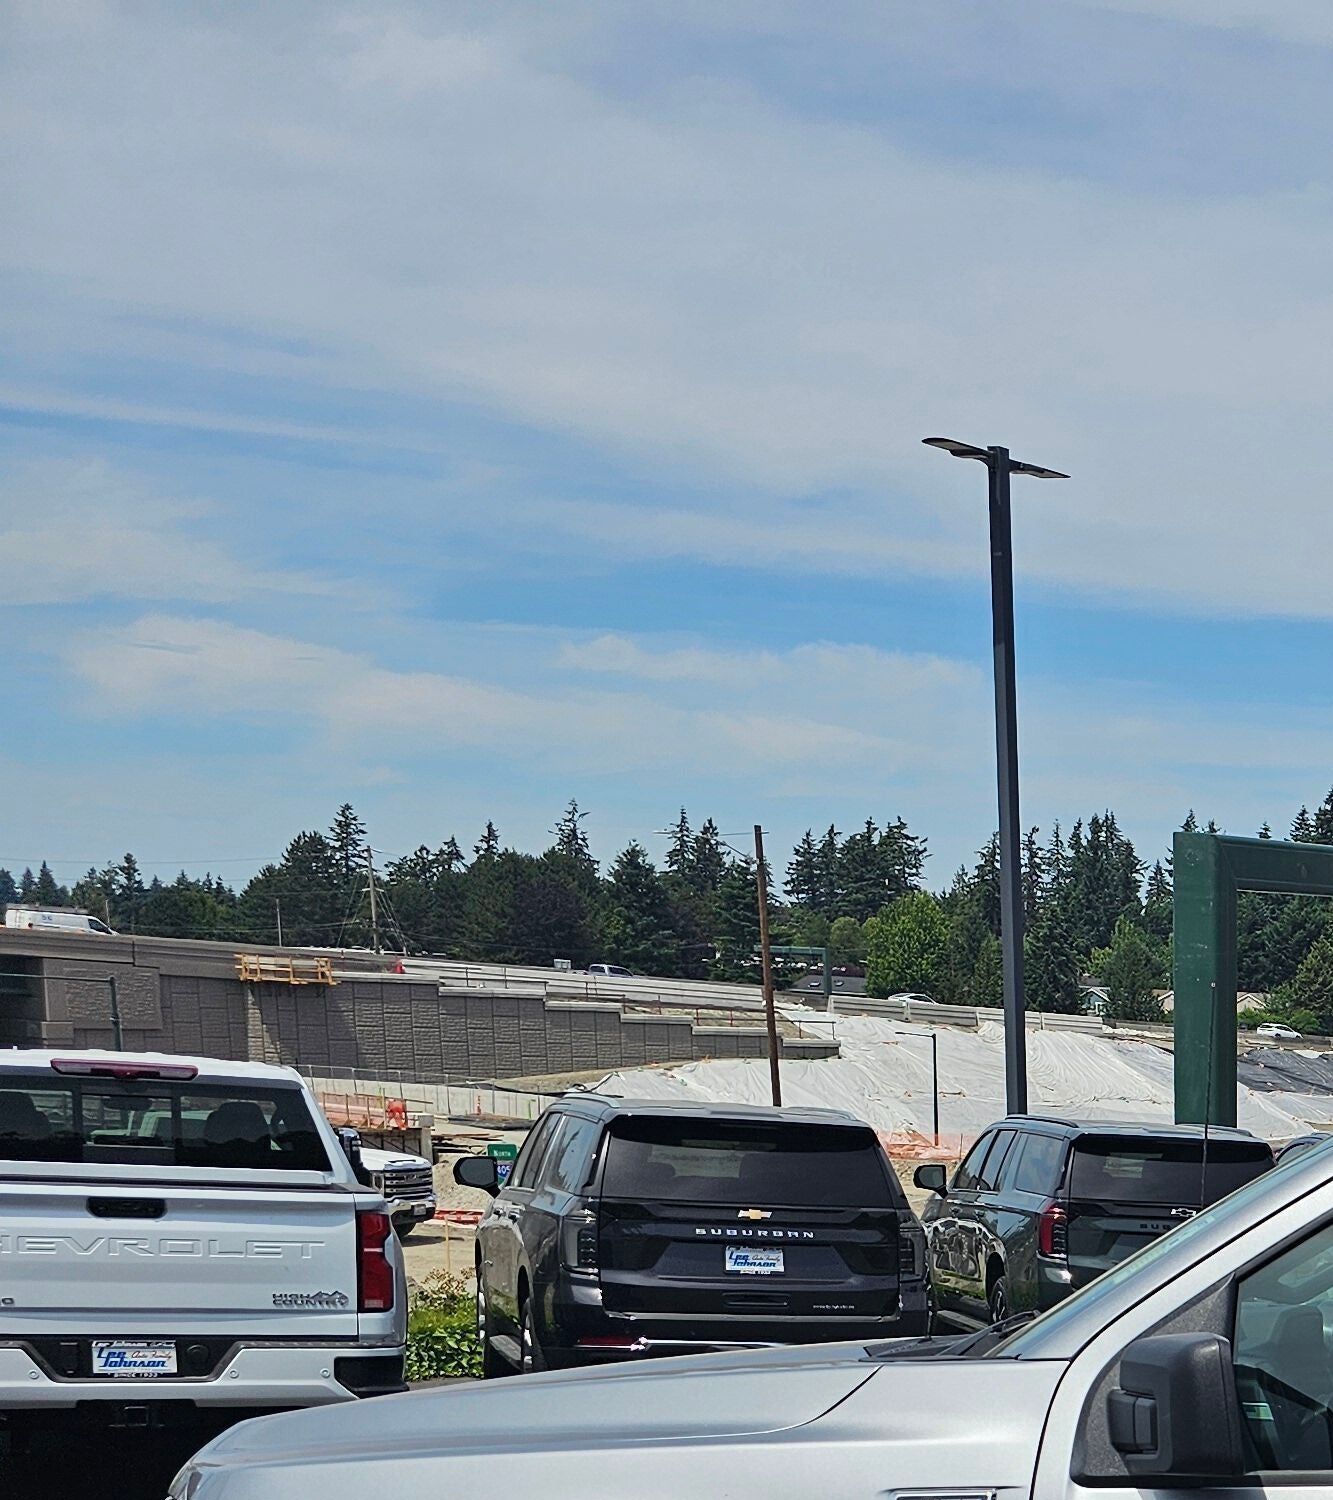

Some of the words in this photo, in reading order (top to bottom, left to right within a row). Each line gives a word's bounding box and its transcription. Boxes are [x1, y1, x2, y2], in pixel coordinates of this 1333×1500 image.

[695, 1228, 814, 1239] SUBURBAN
[0, 1235, 326, 1259] EVROLET
[729, 1250, 749, 1260] Lee
[733, 1258, 776, 1268] Johnson
[97, 1347, 126, 1359] Lee
[98, 1357, 168, 1368] Johnson
